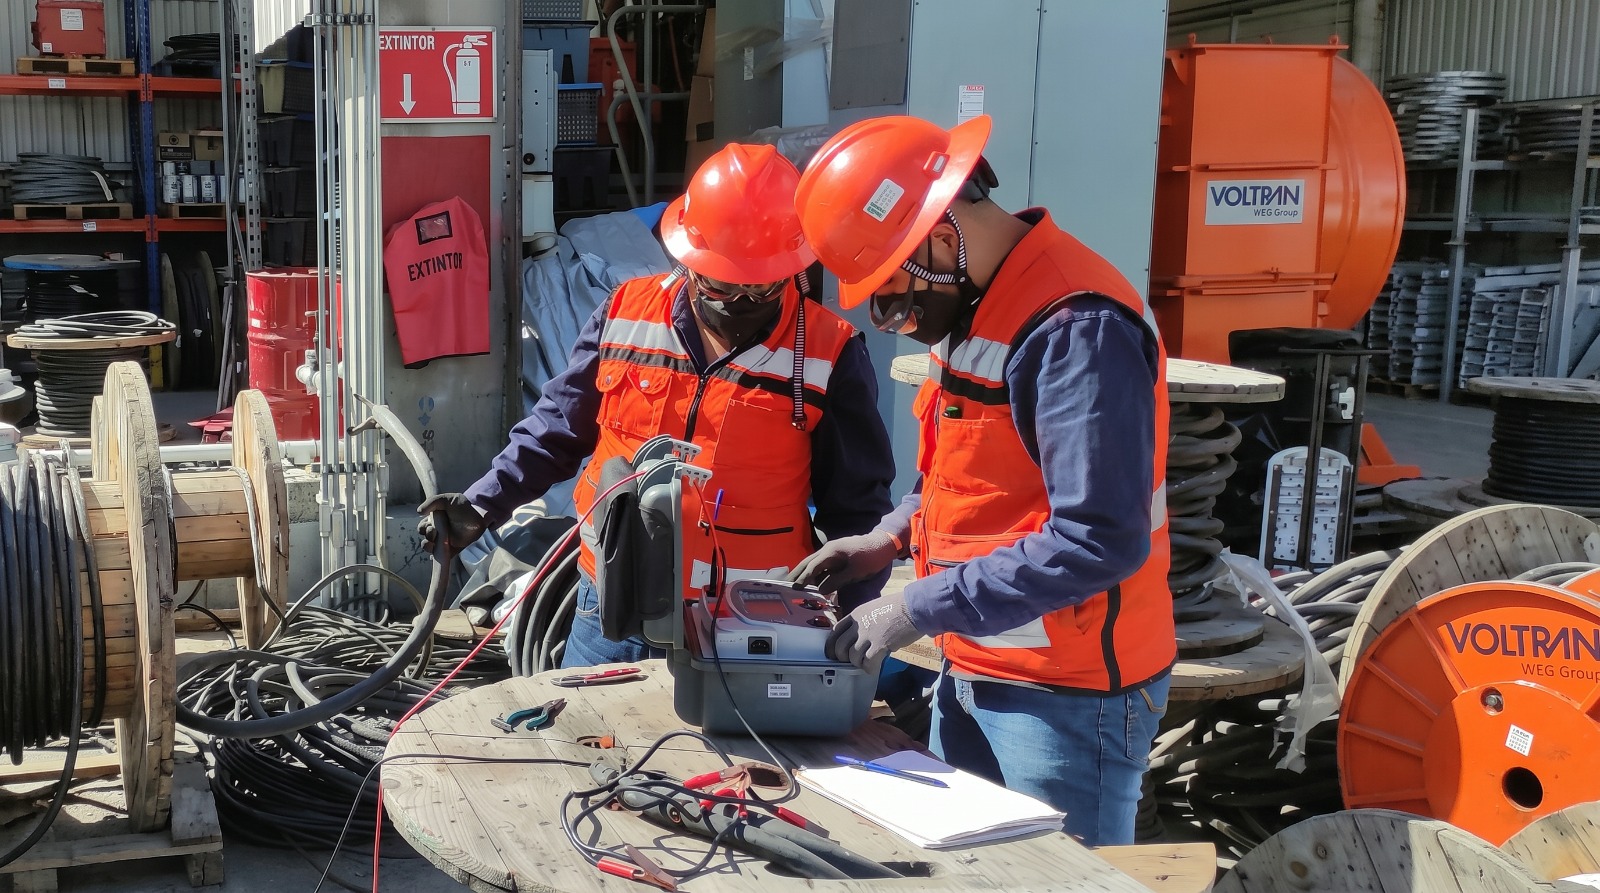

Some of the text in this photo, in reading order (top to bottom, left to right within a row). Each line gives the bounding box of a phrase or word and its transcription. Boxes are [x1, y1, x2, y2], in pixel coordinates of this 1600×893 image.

[379, 35, 435, 50] EXTINTOR
[1210, 185, 1300, 207] VOLTRAN
[1253, 208, 1299, 217] WEG Group
[407, 251, 463, 282] EXTINTOR
[1445, 622, 1600, 661] VOLTRAN
[1521, 662, 1555, 677] WEG
